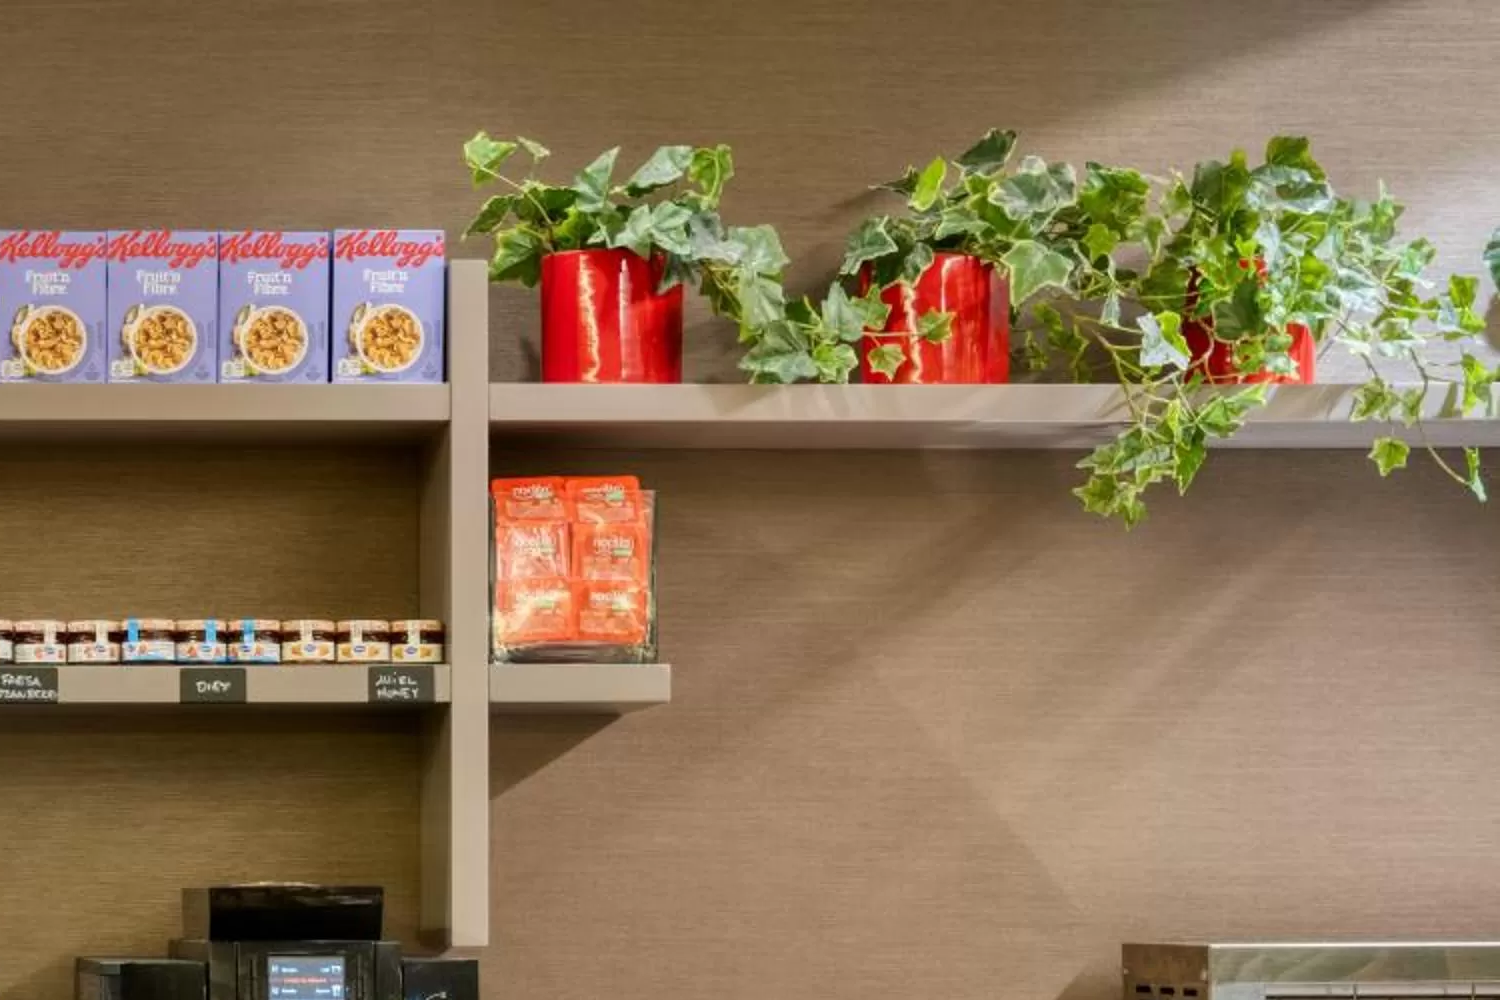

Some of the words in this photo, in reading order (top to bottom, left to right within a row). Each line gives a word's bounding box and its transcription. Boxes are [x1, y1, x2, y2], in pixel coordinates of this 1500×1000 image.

[107, 229, 216, 268] Kellogg's
[219, 231, 328, 269] Kellogg's
[335, 229, 444, 267] Kellogg's
